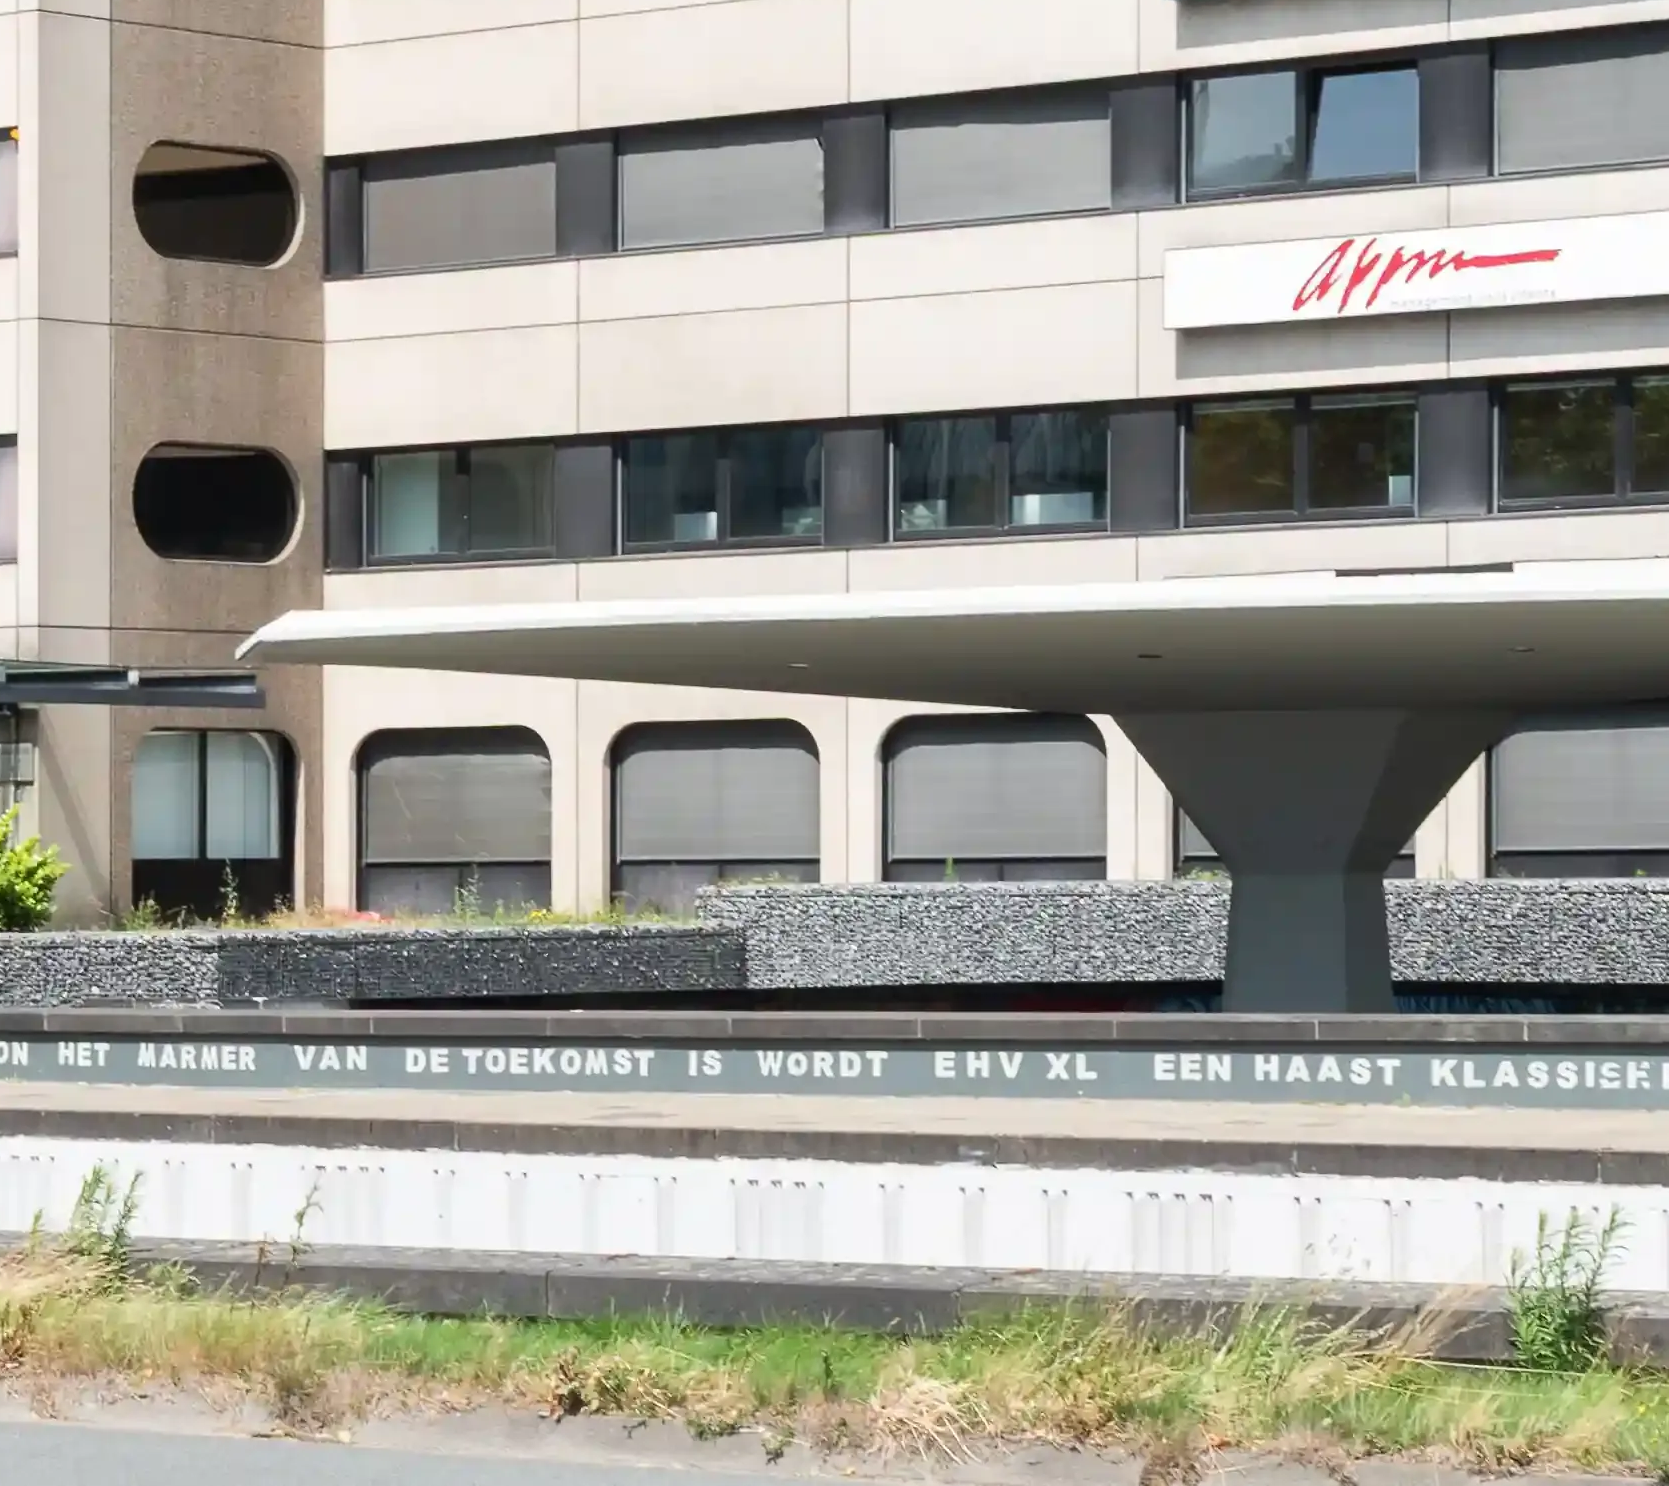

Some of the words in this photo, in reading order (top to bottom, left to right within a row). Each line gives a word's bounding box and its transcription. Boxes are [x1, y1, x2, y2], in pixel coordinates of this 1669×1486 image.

[58, 1041, 110, 1068] HET
[137, 1042, 257, 1071] MARMER
[294, 1044, 369, 1072] VAN
[405, 1047, 451, 1074] DE
[461, 1047, 656, 1078] TOEKOMST
[687, 1050, 723, 1077] IS
[756, 1050, 890, 1078] WORDT
[934, 1051, 1024, 1080] EHV
[1044, 1052, 1099, 1081] XL
[1153, 1053, 1233, 1082] EEN
[1254, 1054, 1402, 1086] HAAST
